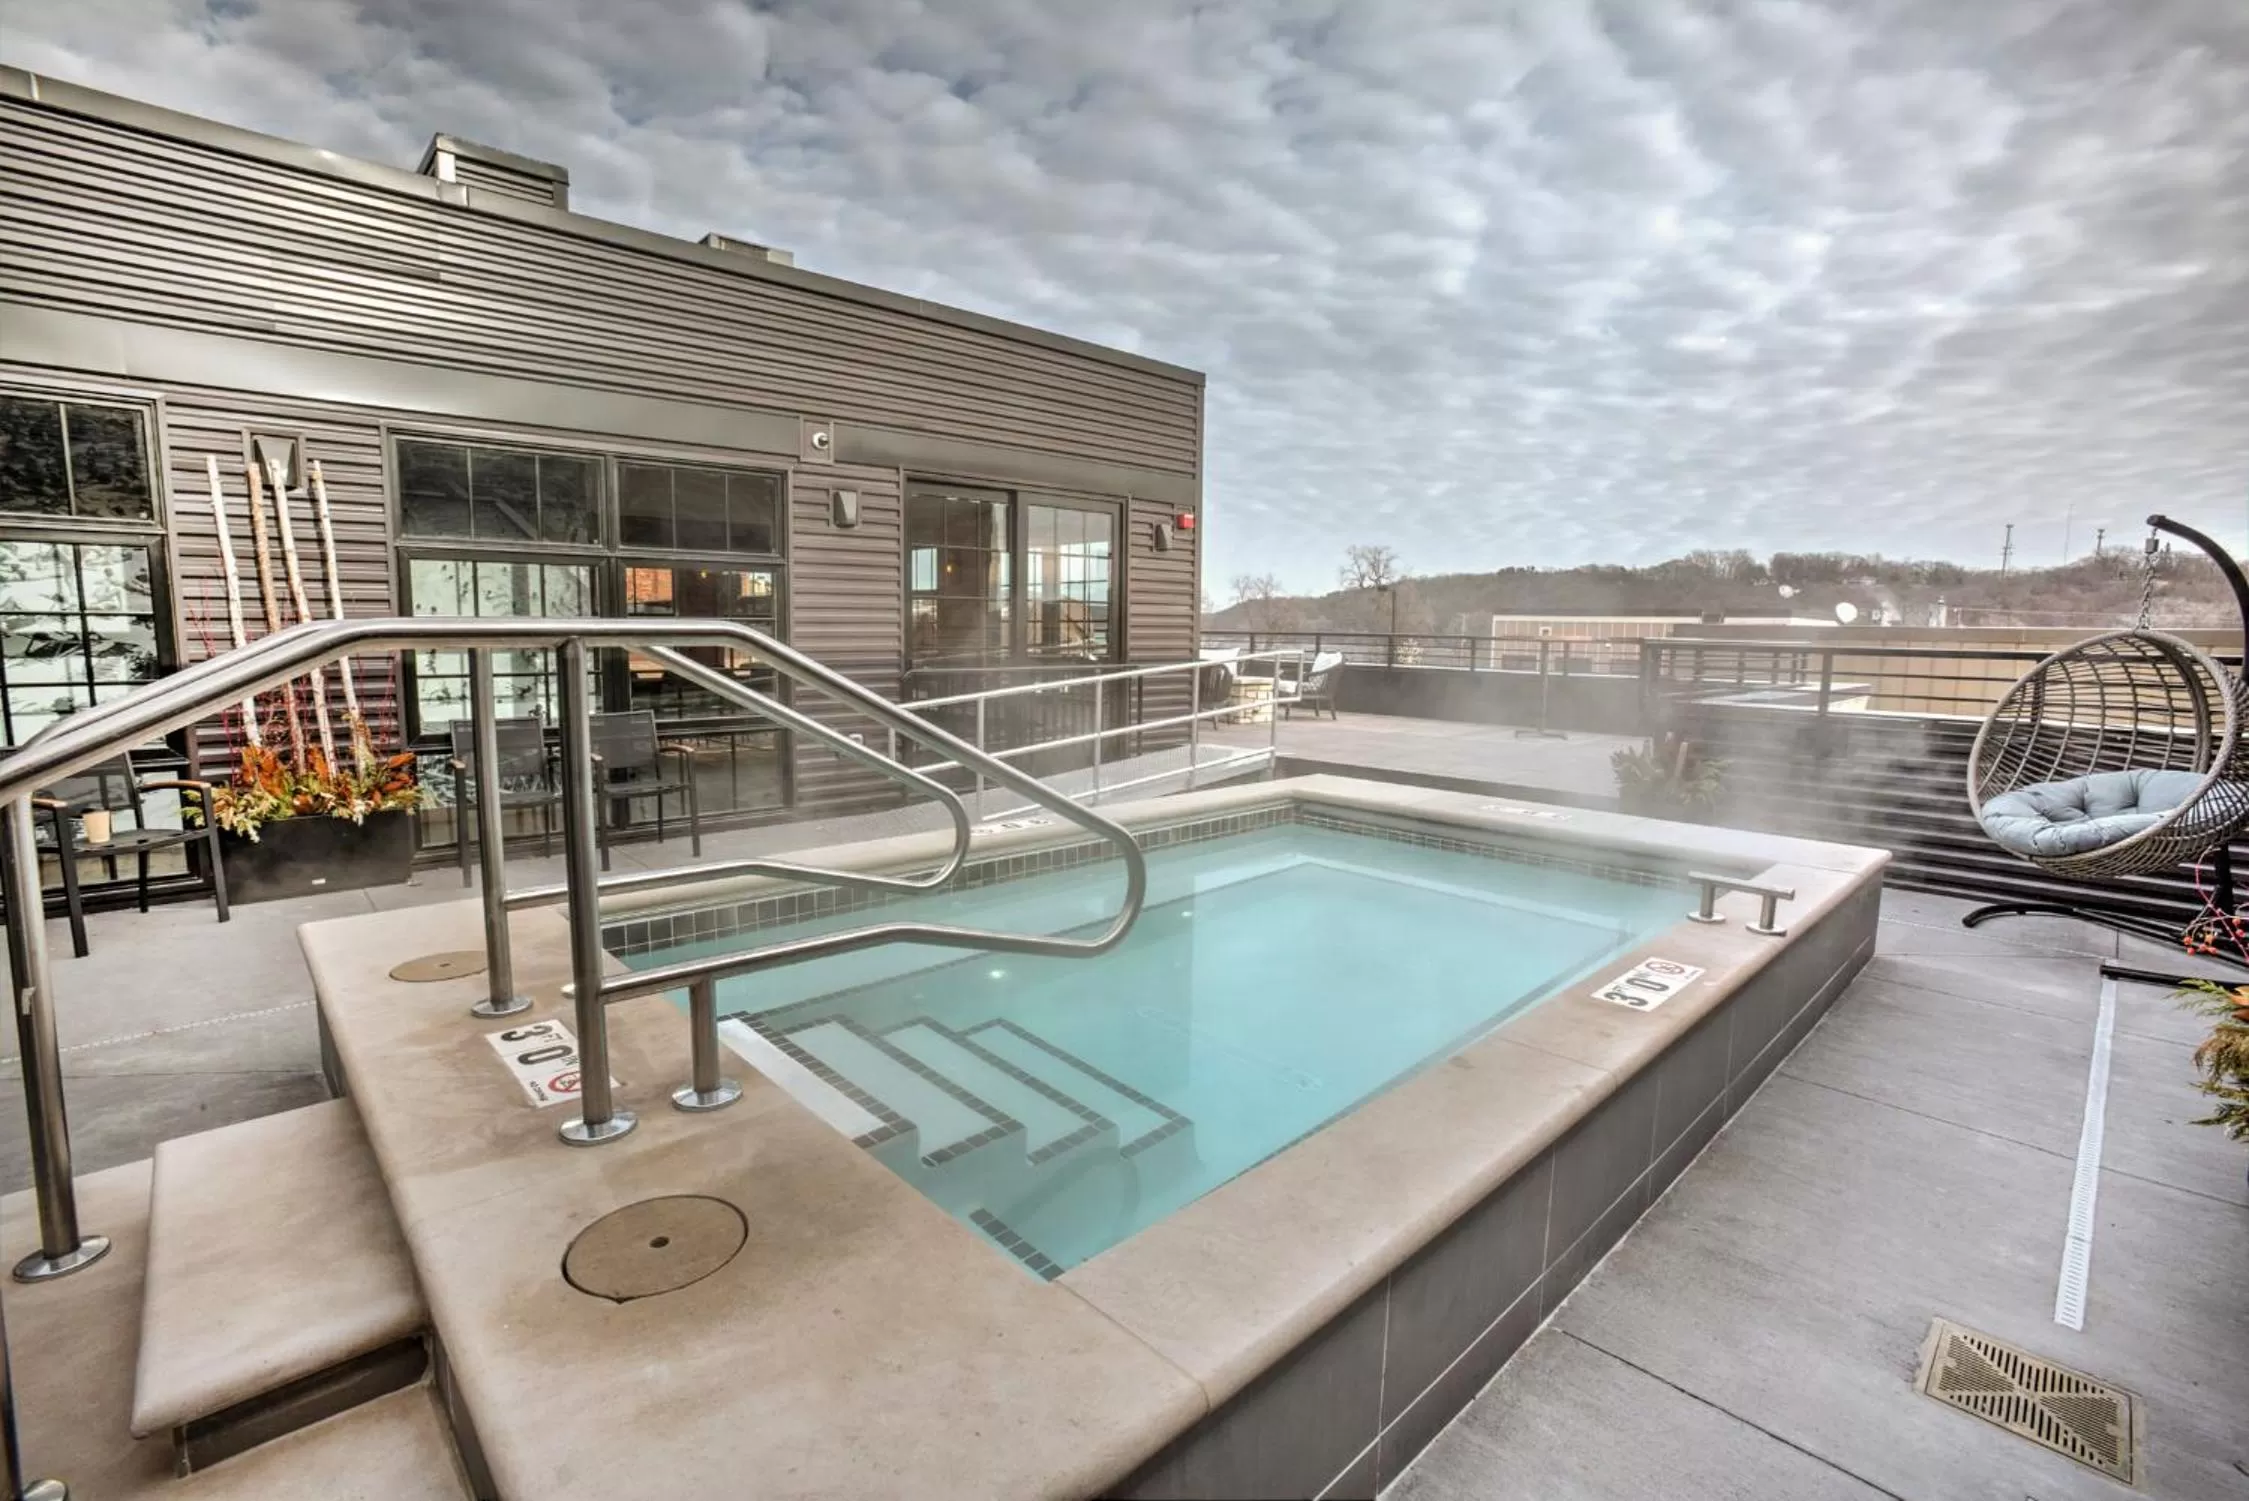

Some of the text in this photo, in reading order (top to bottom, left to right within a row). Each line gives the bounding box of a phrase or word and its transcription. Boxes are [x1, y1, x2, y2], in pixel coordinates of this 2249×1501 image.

[1625, 978, 1670, 992] 0
[1603, 992, 1649, 1007] 3
[501, 1025, 553, 1042] 3
[516, 1045, 573, 1065] 0
